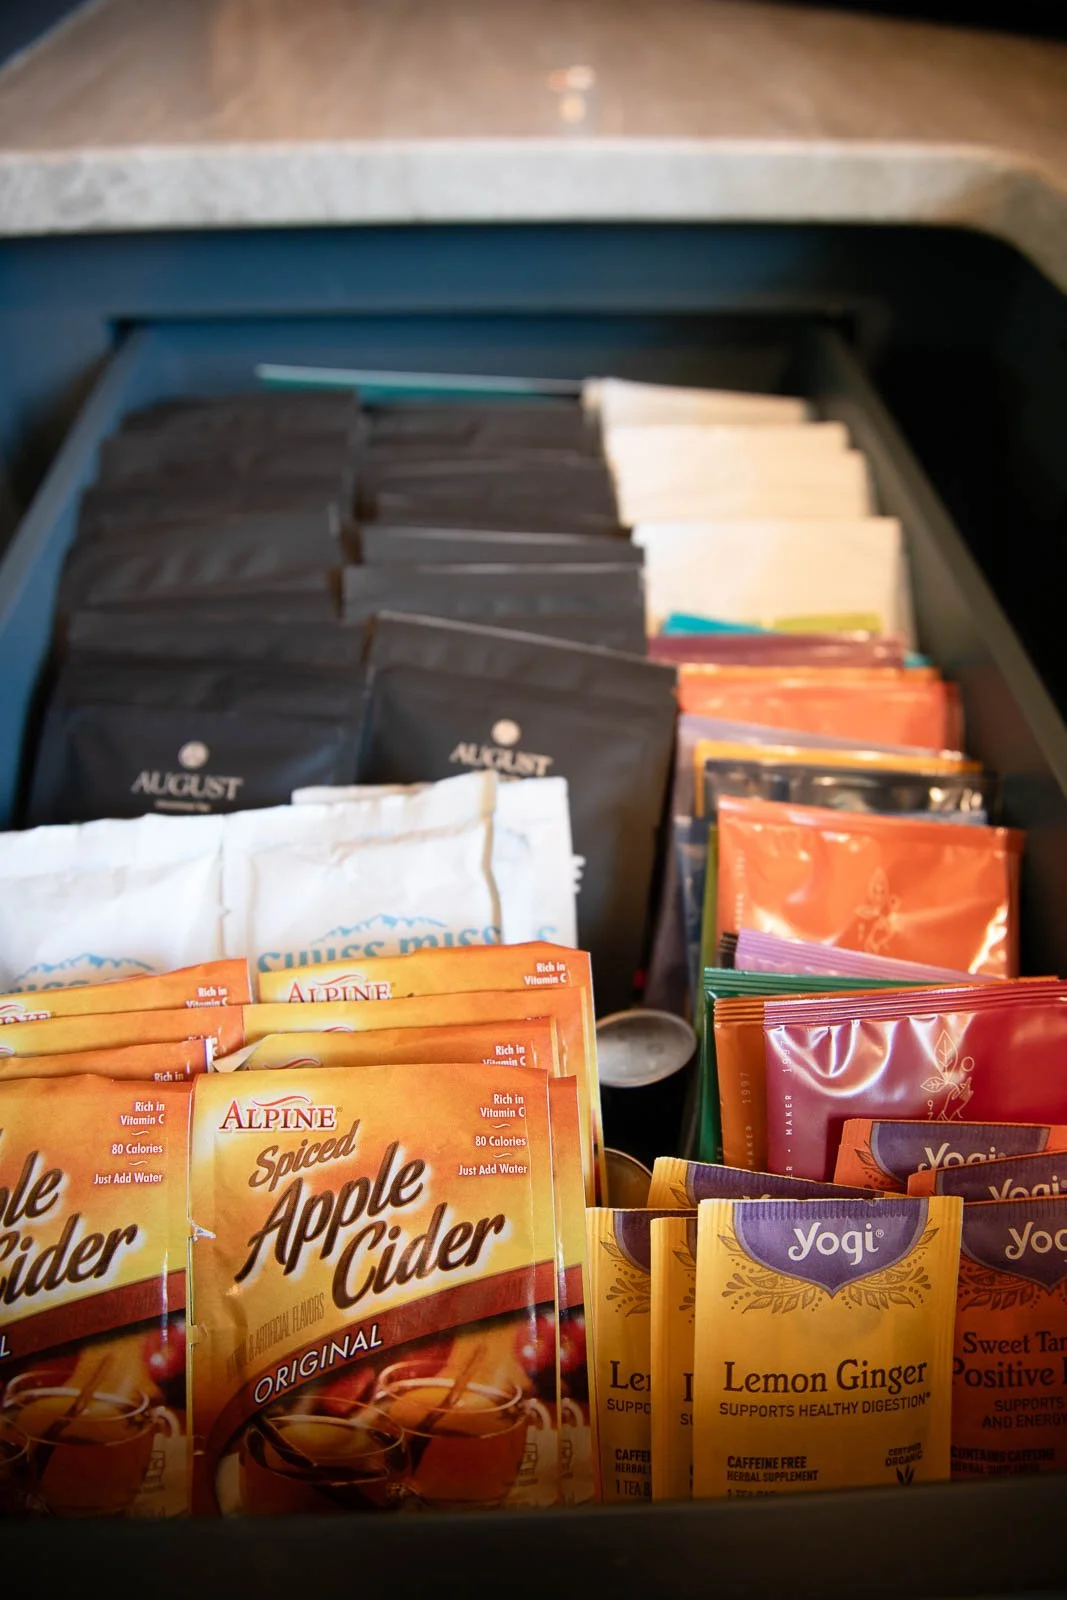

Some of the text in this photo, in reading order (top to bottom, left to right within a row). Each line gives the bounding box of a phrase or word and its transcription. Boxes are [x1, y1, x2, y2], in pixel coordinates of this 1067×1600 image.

[449, 742, 553, 776] AUGUST
[131, 771, 243, 800] AUGUST
[536, 962, 565, 972] Rich in
[523, 973, 567, 985] Vitamin C
[198, 986, 227, 997] Rich in
[288, 981, 389, 1002] ALPINE
[495, 1045, 525, 1056] Rich in
[153, 1071, 184, 1081] Rich in
[493, 1093, 524, 1104] Rich in
[135, 1101, 165, 1112] Rich in
[480, 1107, 525, 1118] Vitamin C
[120, 1114, 165, 1126] Vitamin C
[218, 1099, 336, 1129] ALPINE
[785, 1094, 794, 1136] MAKER
[475, 1135, 527, 1147] 80 Calories
[112, 1143, 163, 1155] 80 Calories
[249, 1119, 360, 1192] Spiced
[458, 1163, 528, 1176] Just Add Water
[94, 1172, 163, 1185] Just Add Water
[234, 1141, 426, 1283] Apple
[332, 1202, 506, 1309] Cider
[293, 1292, 325, 1333] FLAVORS
[963, 1331, 1029, 1354] Sweet
[254, 1324, 382, 1403] ORIGINAL
[723, 1361, 828, 1393] Lemon
[836, 1359, 927, 1395] Ginger
[719, 1402, 795, 1418] SUPPORTS
[799, 1401, 858, 1417] HEALTHY
[995, 1396, 1065, 1412] SUPPORTS
[982, 1415, 1013, 1429] AND
[727, 1456, 807, 1469] CAFFEINE FREE
[885, 1450, 923, 1467] ORGANIC
[727, 1470, 819, 1482] HERBAL SUPPLEMENT
